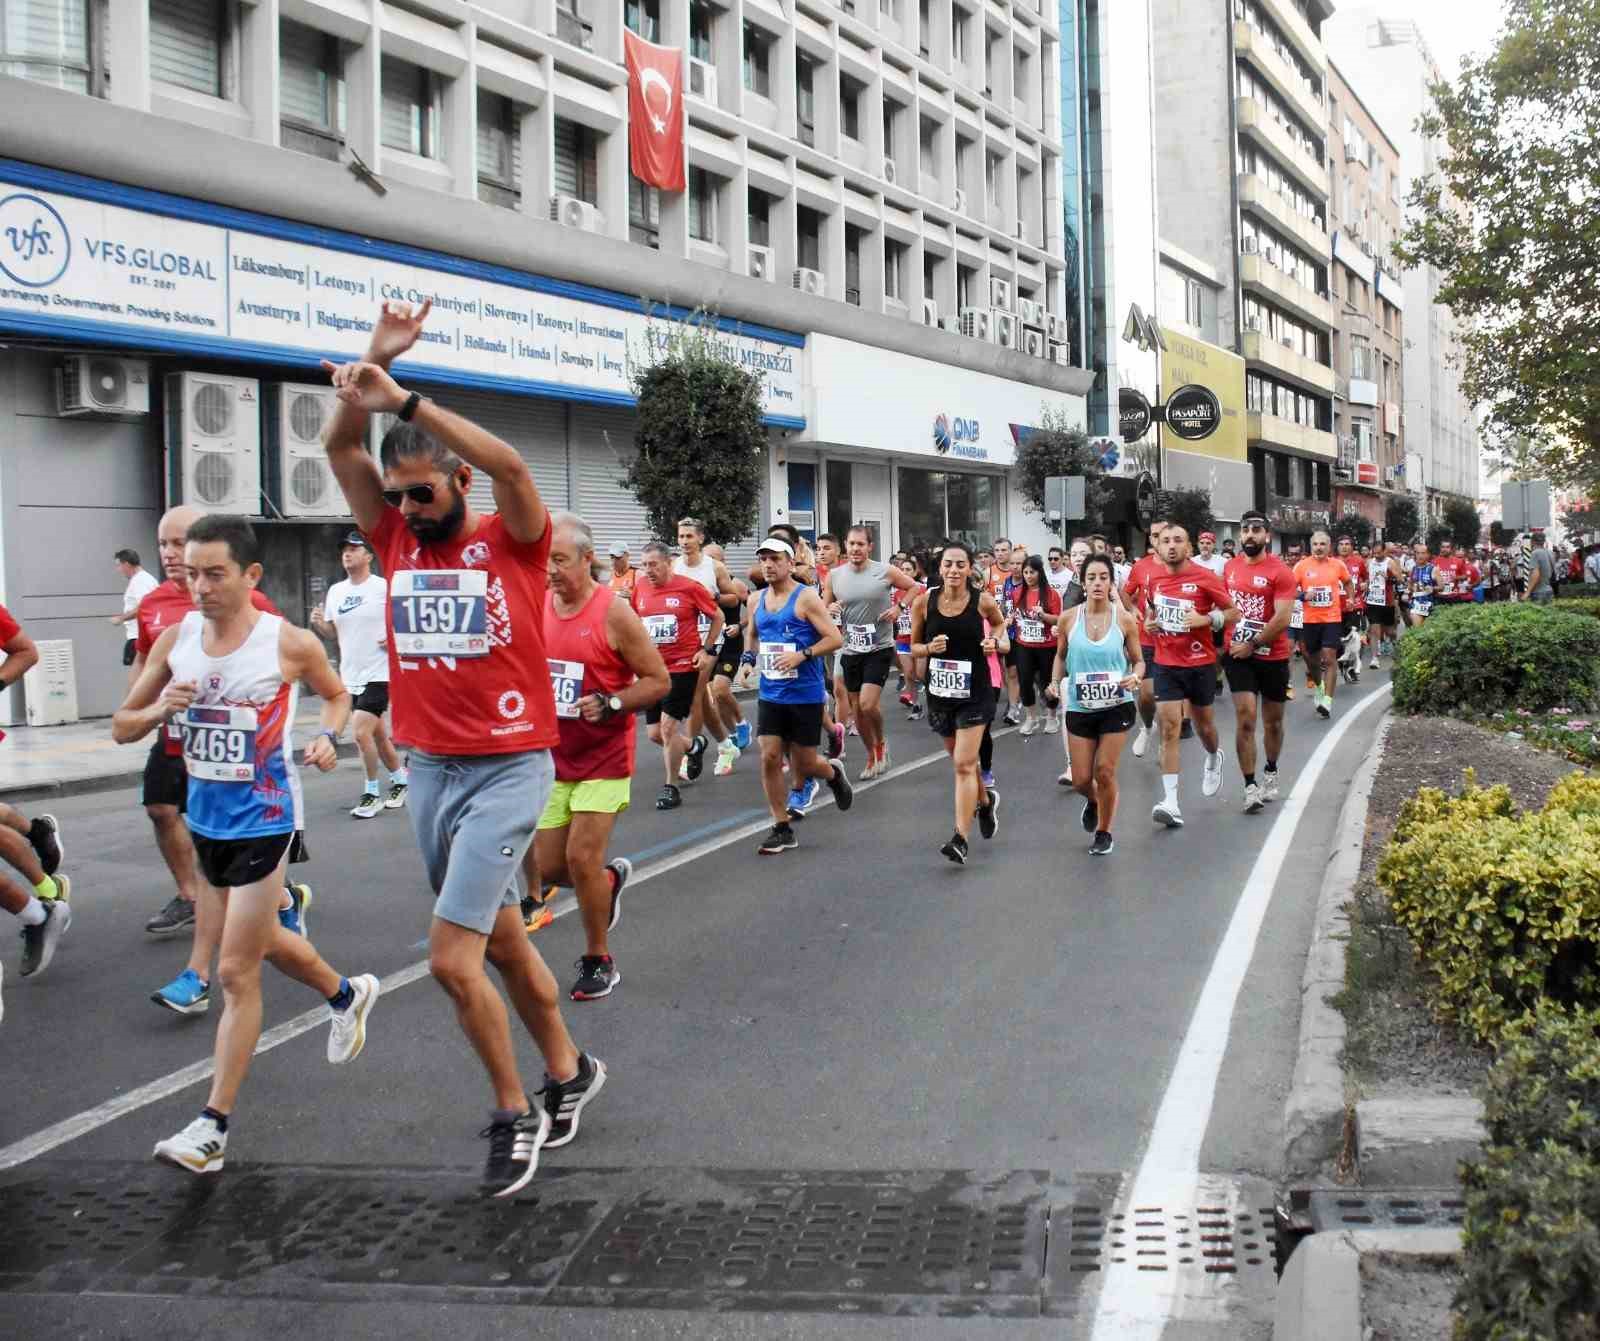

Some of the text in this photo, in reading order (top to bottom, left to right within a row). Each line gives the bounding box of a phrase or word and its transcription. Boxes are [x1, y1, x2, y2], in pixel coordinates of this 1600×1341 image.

[84, 238, 217, 280] VFS.GLOBAL
[0, 288, 48, 305] artnering
[127, 303, 170, 322] Providing
[232, 255, 304, 285] Lüksemburg
[314, 270, 366, 294] Letonya
[485, 304, 528, 325] Slovenya
[537, 313, 573, 333] Estonya
[237, 299, 301, 324] Avusturya
[316, 310, 373, 331] Bulgarista
[464, 334, 507, 354] Hollanda
[518, 339, 551, 360] İrlanda
[561, 350, 593, 369] Slovakya
[1172, 409, 1211, 418] PASAPORT
[953, 416, 980, 441] QNB
[402, 596, 476, 633] 1597
[1235, 630, 1253, 643] 32
[552, 678, 575, 703] 46
[930, 670, 966, 690] 3503
[1081, 684, 1119, 700] 3502
[183, 727, 246, 763] 2469
